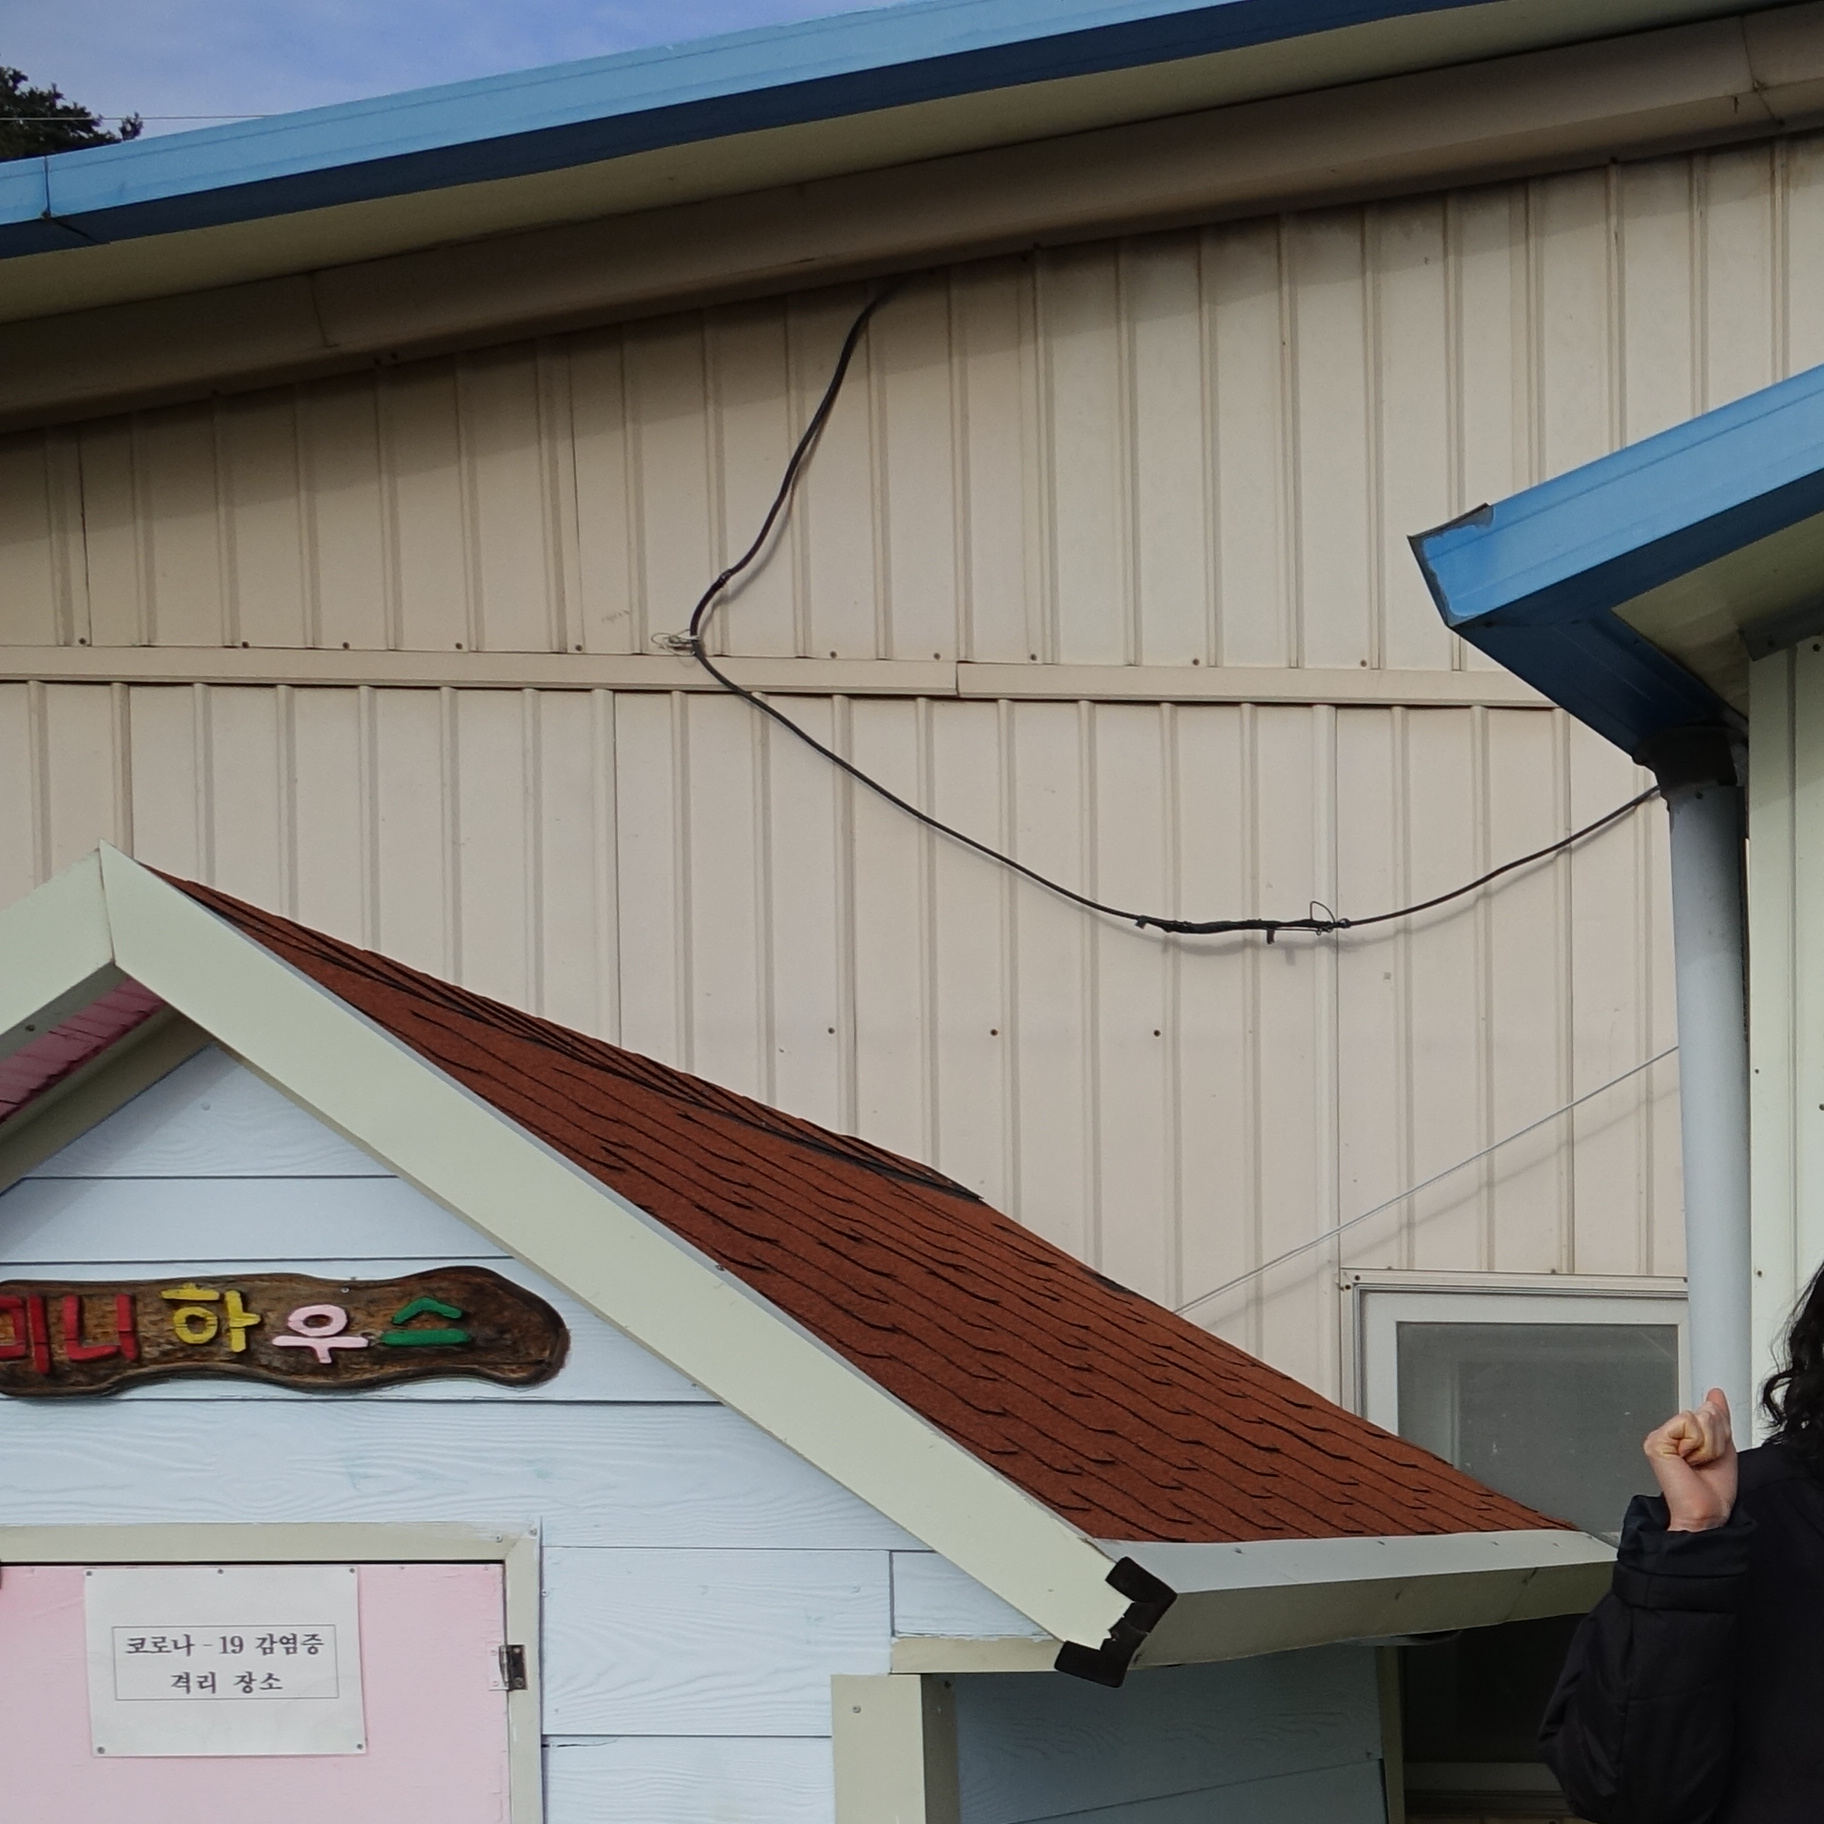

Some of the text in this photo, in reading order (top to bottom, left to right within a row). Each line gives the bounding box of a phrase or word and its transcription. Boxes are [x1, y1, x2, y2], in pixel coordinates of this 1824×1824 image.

[255, 1632, 324, 1656] 감염증
[170, 1671, 284, 1694] 격리 장소
